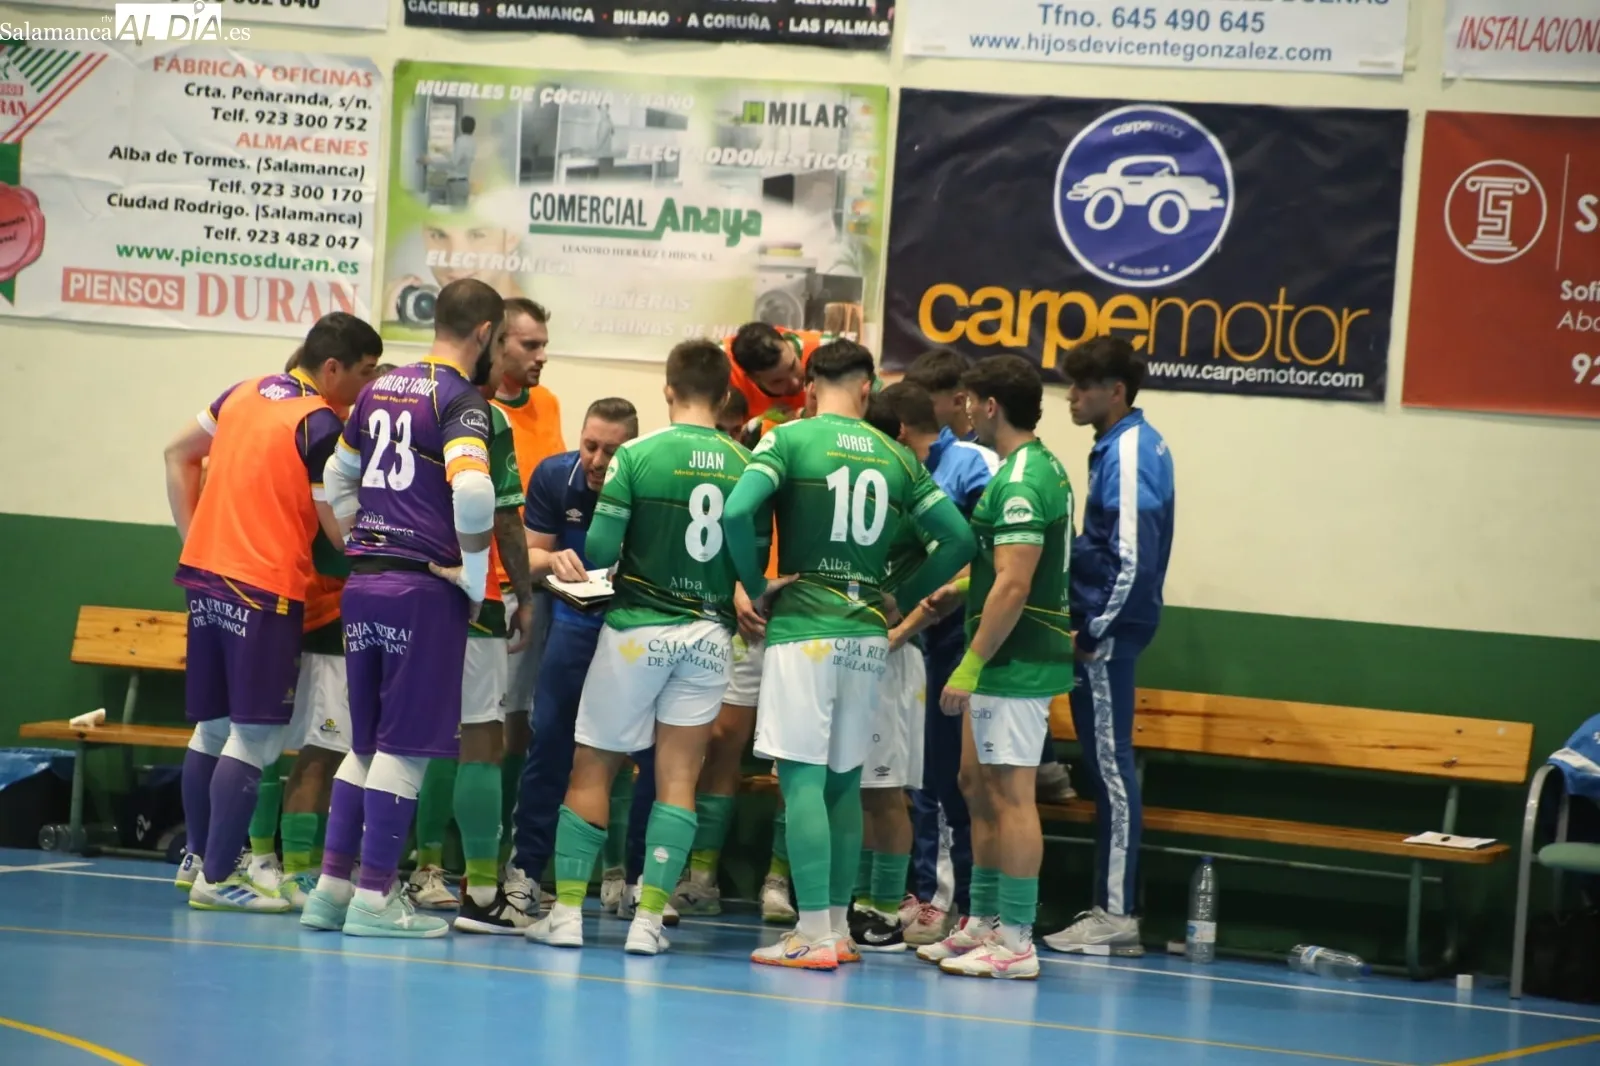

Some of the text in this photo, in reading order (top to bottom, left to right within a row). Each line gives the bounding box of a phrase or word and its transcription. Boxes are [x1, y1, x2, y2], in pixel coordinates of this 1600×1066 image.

[497, 4, 595, 23] SALAMANCA
[613, 9, 669, 26] BILBAO
[687, 13, 699, 27] A
[703, 12, 770, 31] CORUÑA
[789, 17, 820, 33] LAS
[824, 19, 890, 36] PALMAS
[1039, 4, 1265, 33] Tfno. 645 490 645
[970, 33, 1331, 61] www.hijosdevicentegonzalez.com
[1457, 16, 1600, 53] INSTALACION
[153, 54, 373, 88] FÁBRICA Y OFICINAS
[184, 82, 372, 112] Crta. Peñaranda, s/n.
[415, 80, 504, 100] MUEBLES
[510, 84, 535, 102] DE
[540, 88, 613, 107] COCINA
[211, 107, 368, 132] Telf. 923 300 752
[768, 101, 848, 128] MILAR
[236, 131, 369, 157] ALMACENES
[108, 146, 366, 183] Alba de Tormes. (Salamanca)
[208, 178, 363, 203] Telf. 923 300 170
[107, 192, 363, 228] Ciudad Rodrigo. (Salamanca)
[529, 192, 762, 247] COMERCIAL Anaya
[204, 225, 360, 250] Telf. 923 482 047
[562, 244, 610, 256] LEANDRO
[116, 243, 359, 275] www.piensosduran.es
[426, 249, 573, 276] ELECTRÓNICA
[69, 272, 359, 324] PIENSOS DURAN
[918, 283, 1370, 369] carpemotor
[1148, 362, 1364, 388] www.carpemotor.com
[362, 408, 415, 491] 23
[836, 432, 874, 453] JORGE
[688, 450, 724, 470] JUAN
[826, 465, 889, 546] 10
[685, 483, 724, 562] 8
[817, 557, 851, 571] Alba
[670, 576, 702, 590] Alba
[193, 615, 206, 628] DE
[346, 622, 373, 640] CAJA
[648, 639, 688, 656] CAJA
[647, 656, 664, 667] DE
